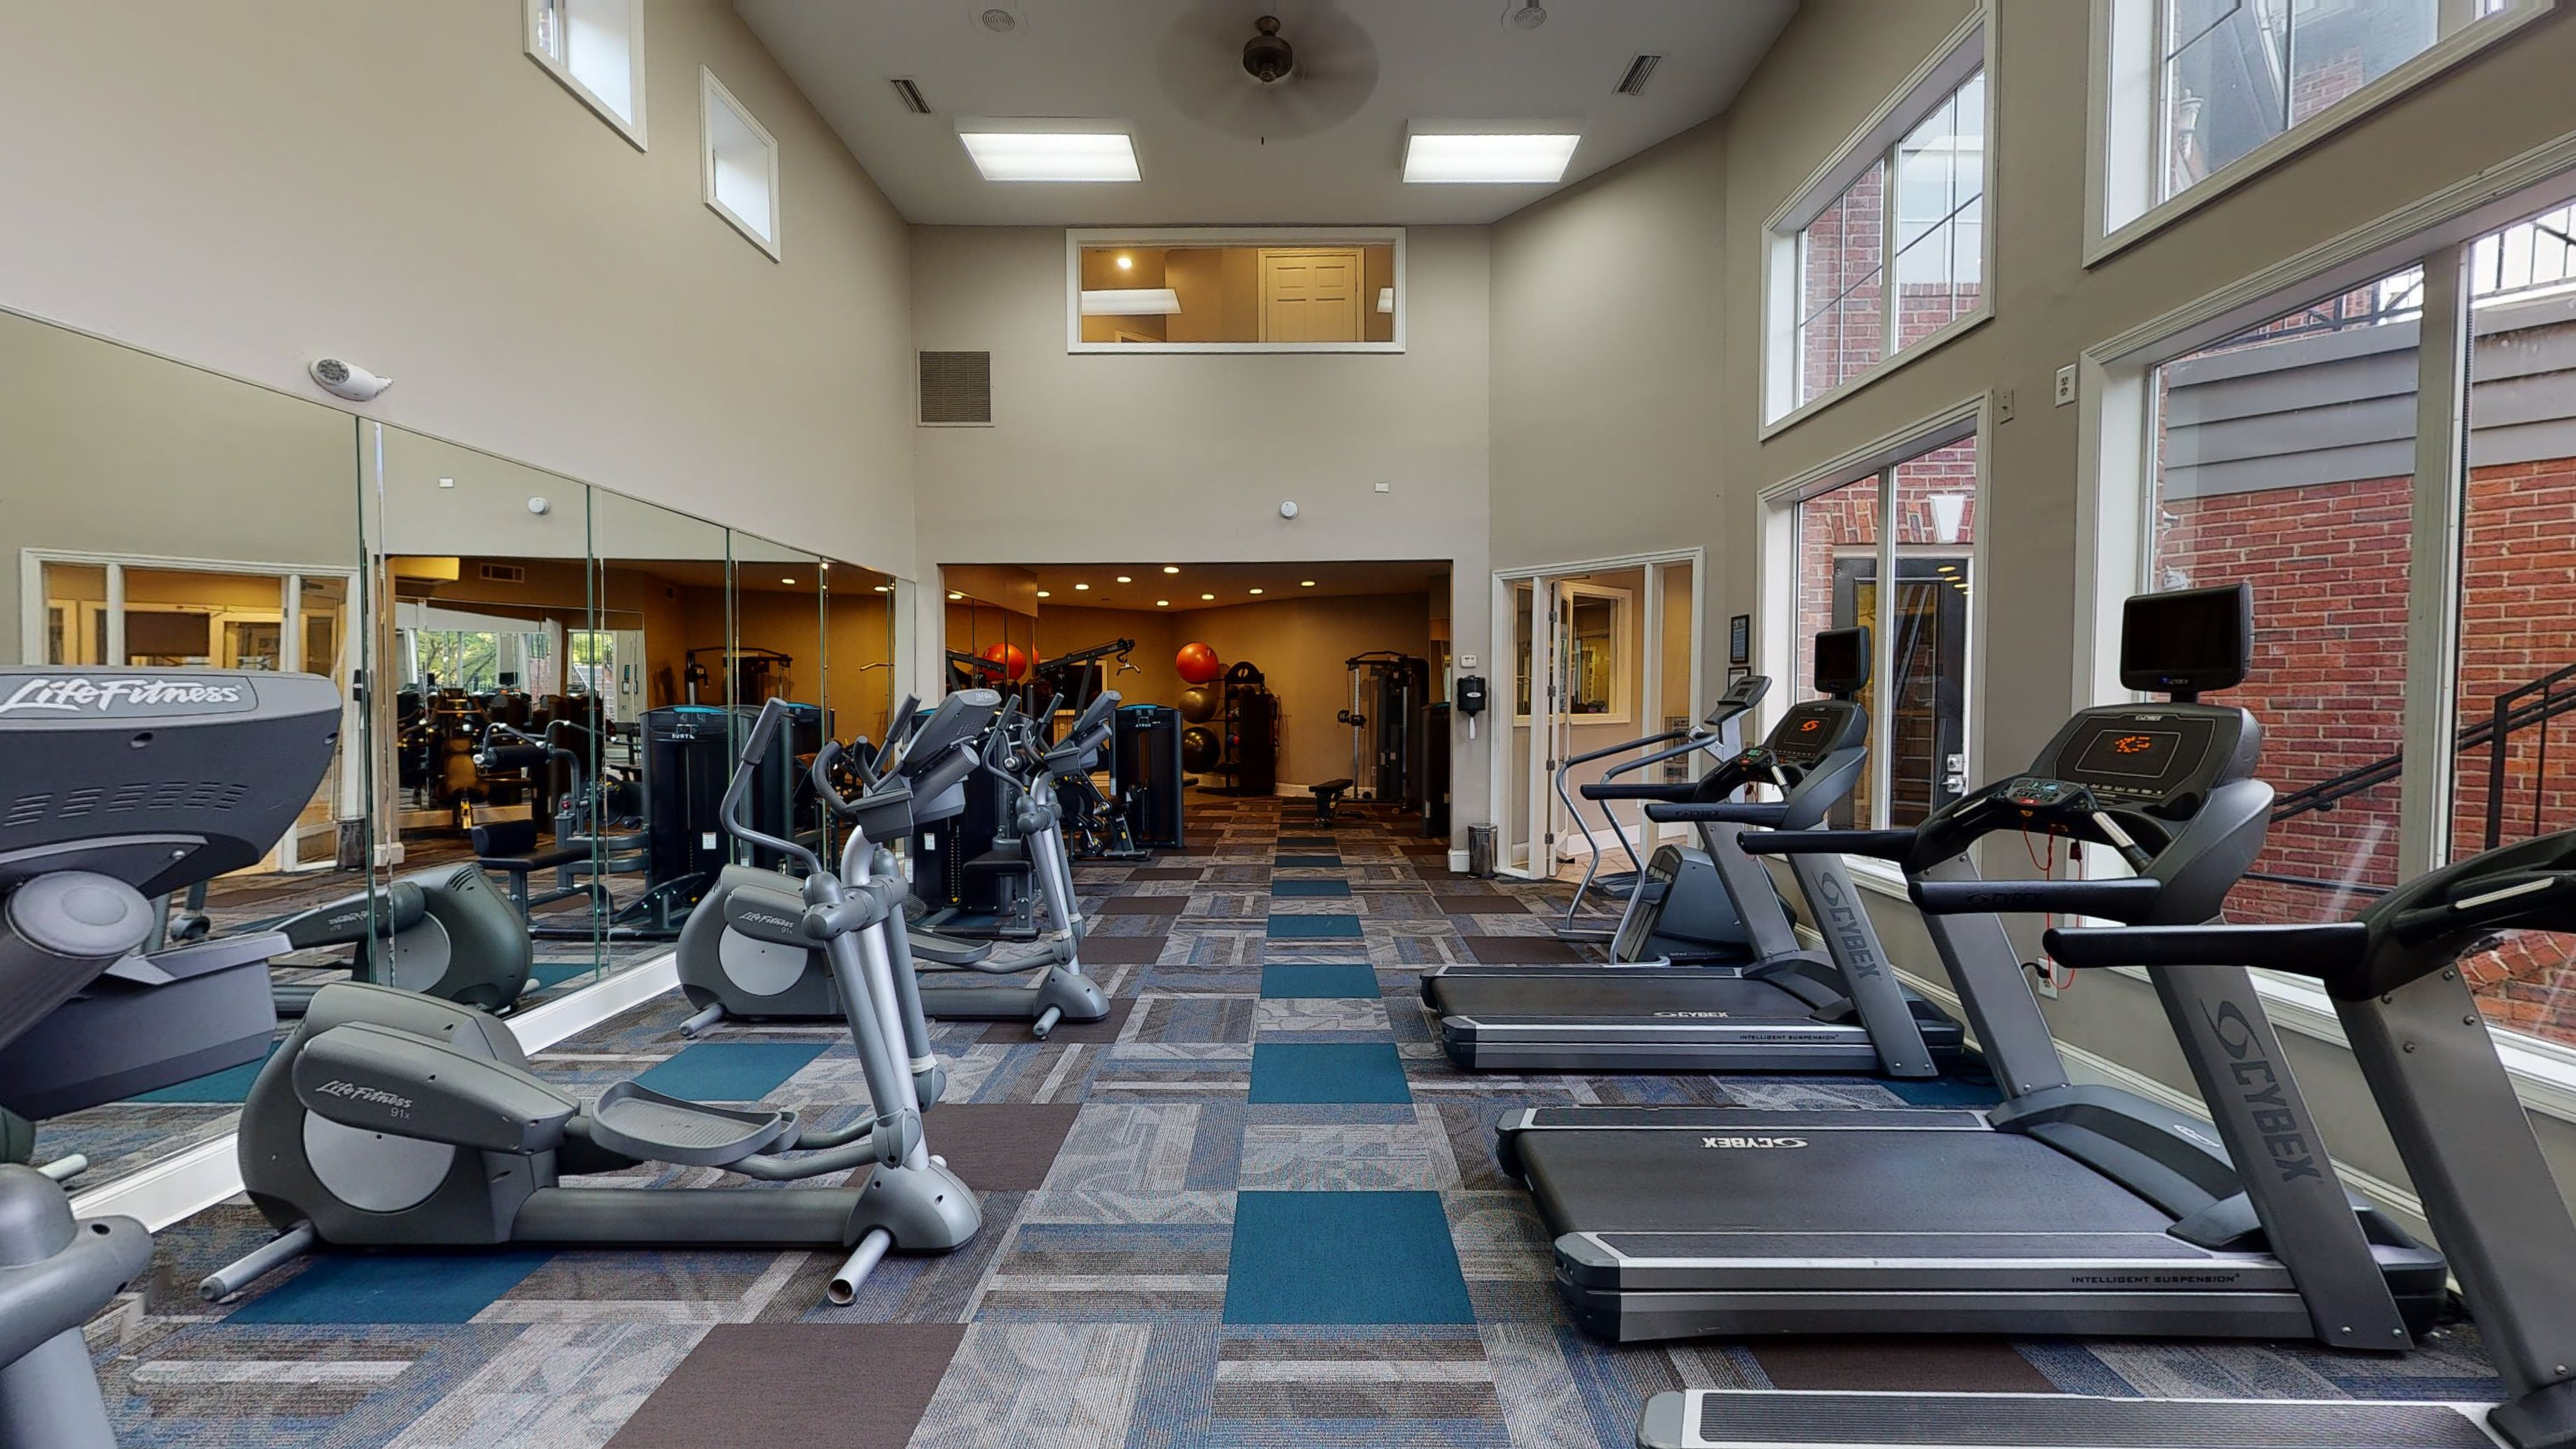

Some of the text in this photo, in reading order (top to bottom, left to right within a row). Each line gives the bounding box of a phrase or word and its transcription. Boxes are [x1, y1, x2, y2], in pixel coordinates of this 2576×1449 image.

[1829, 907, 1881, 980] CYBEX
[1701, 1137, 1775, 1148] CYBEX
[2230, 1060, 2322, 1182] CYBEX
